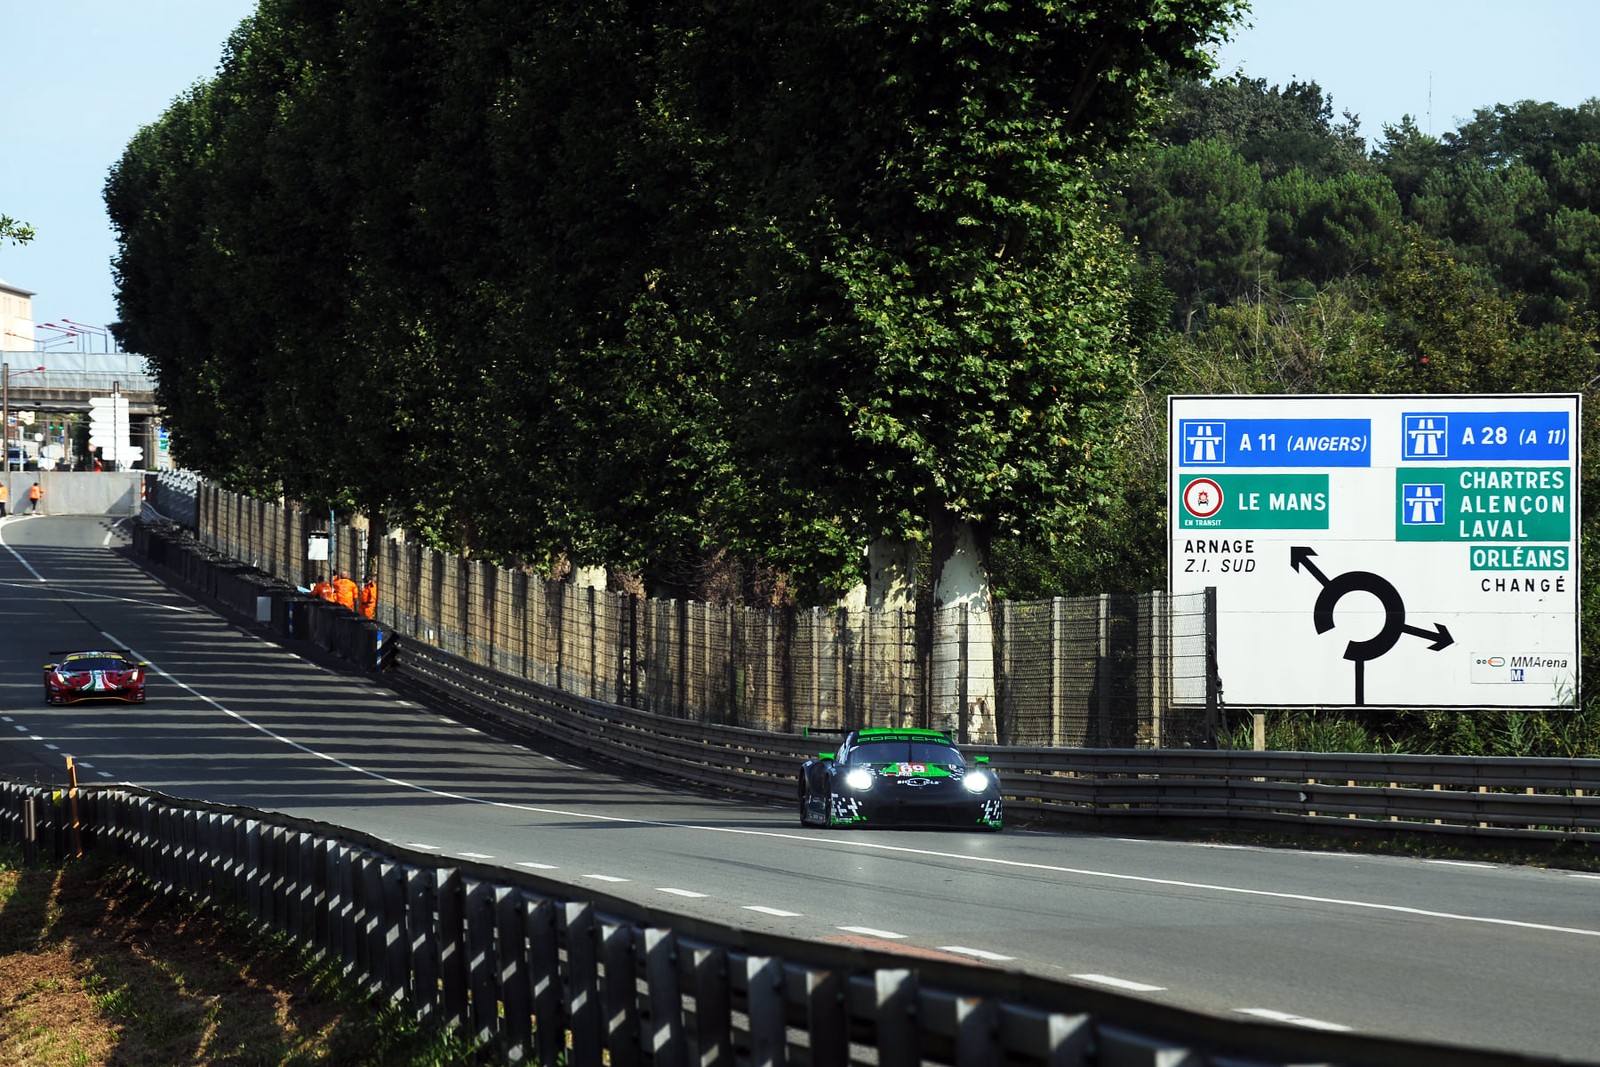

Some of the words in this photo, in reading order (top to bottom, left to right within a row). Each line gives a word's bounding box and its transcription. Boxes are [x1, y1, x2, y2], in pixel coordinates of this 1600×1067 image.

[1239, 433, 1252, 451] A
[1258, 433, 1276, 451] 11
[1287, 435, 1367, 453] (ANGERS)
[1462, 427, 1475, 445] A
[1481, 426, 1507, 445] 28
[1460, 471, 1564, 489] CHARTRES
[1239, 493, 1260, 511] LE
[1270, 493, 1326, 511] MANS
[1460, 495, 1564, 515] ALENÇON
[1460, 520, 1528, 538] LAVAL
[1184, 540, 1254, 554] ARNAGE
[1184, 559, 1211, 573] Z.I.
[1221, 559, 1256, 573] SUD
[1473, 546, 1565, 568] ORLÉANS
[1481, 575, 1565, 592] CHANGÉ
[1510, 656, 1568, 668] MMArena
[857, 735, 949, 744] PORSCHE
[900, 764, 925, 773] 69
